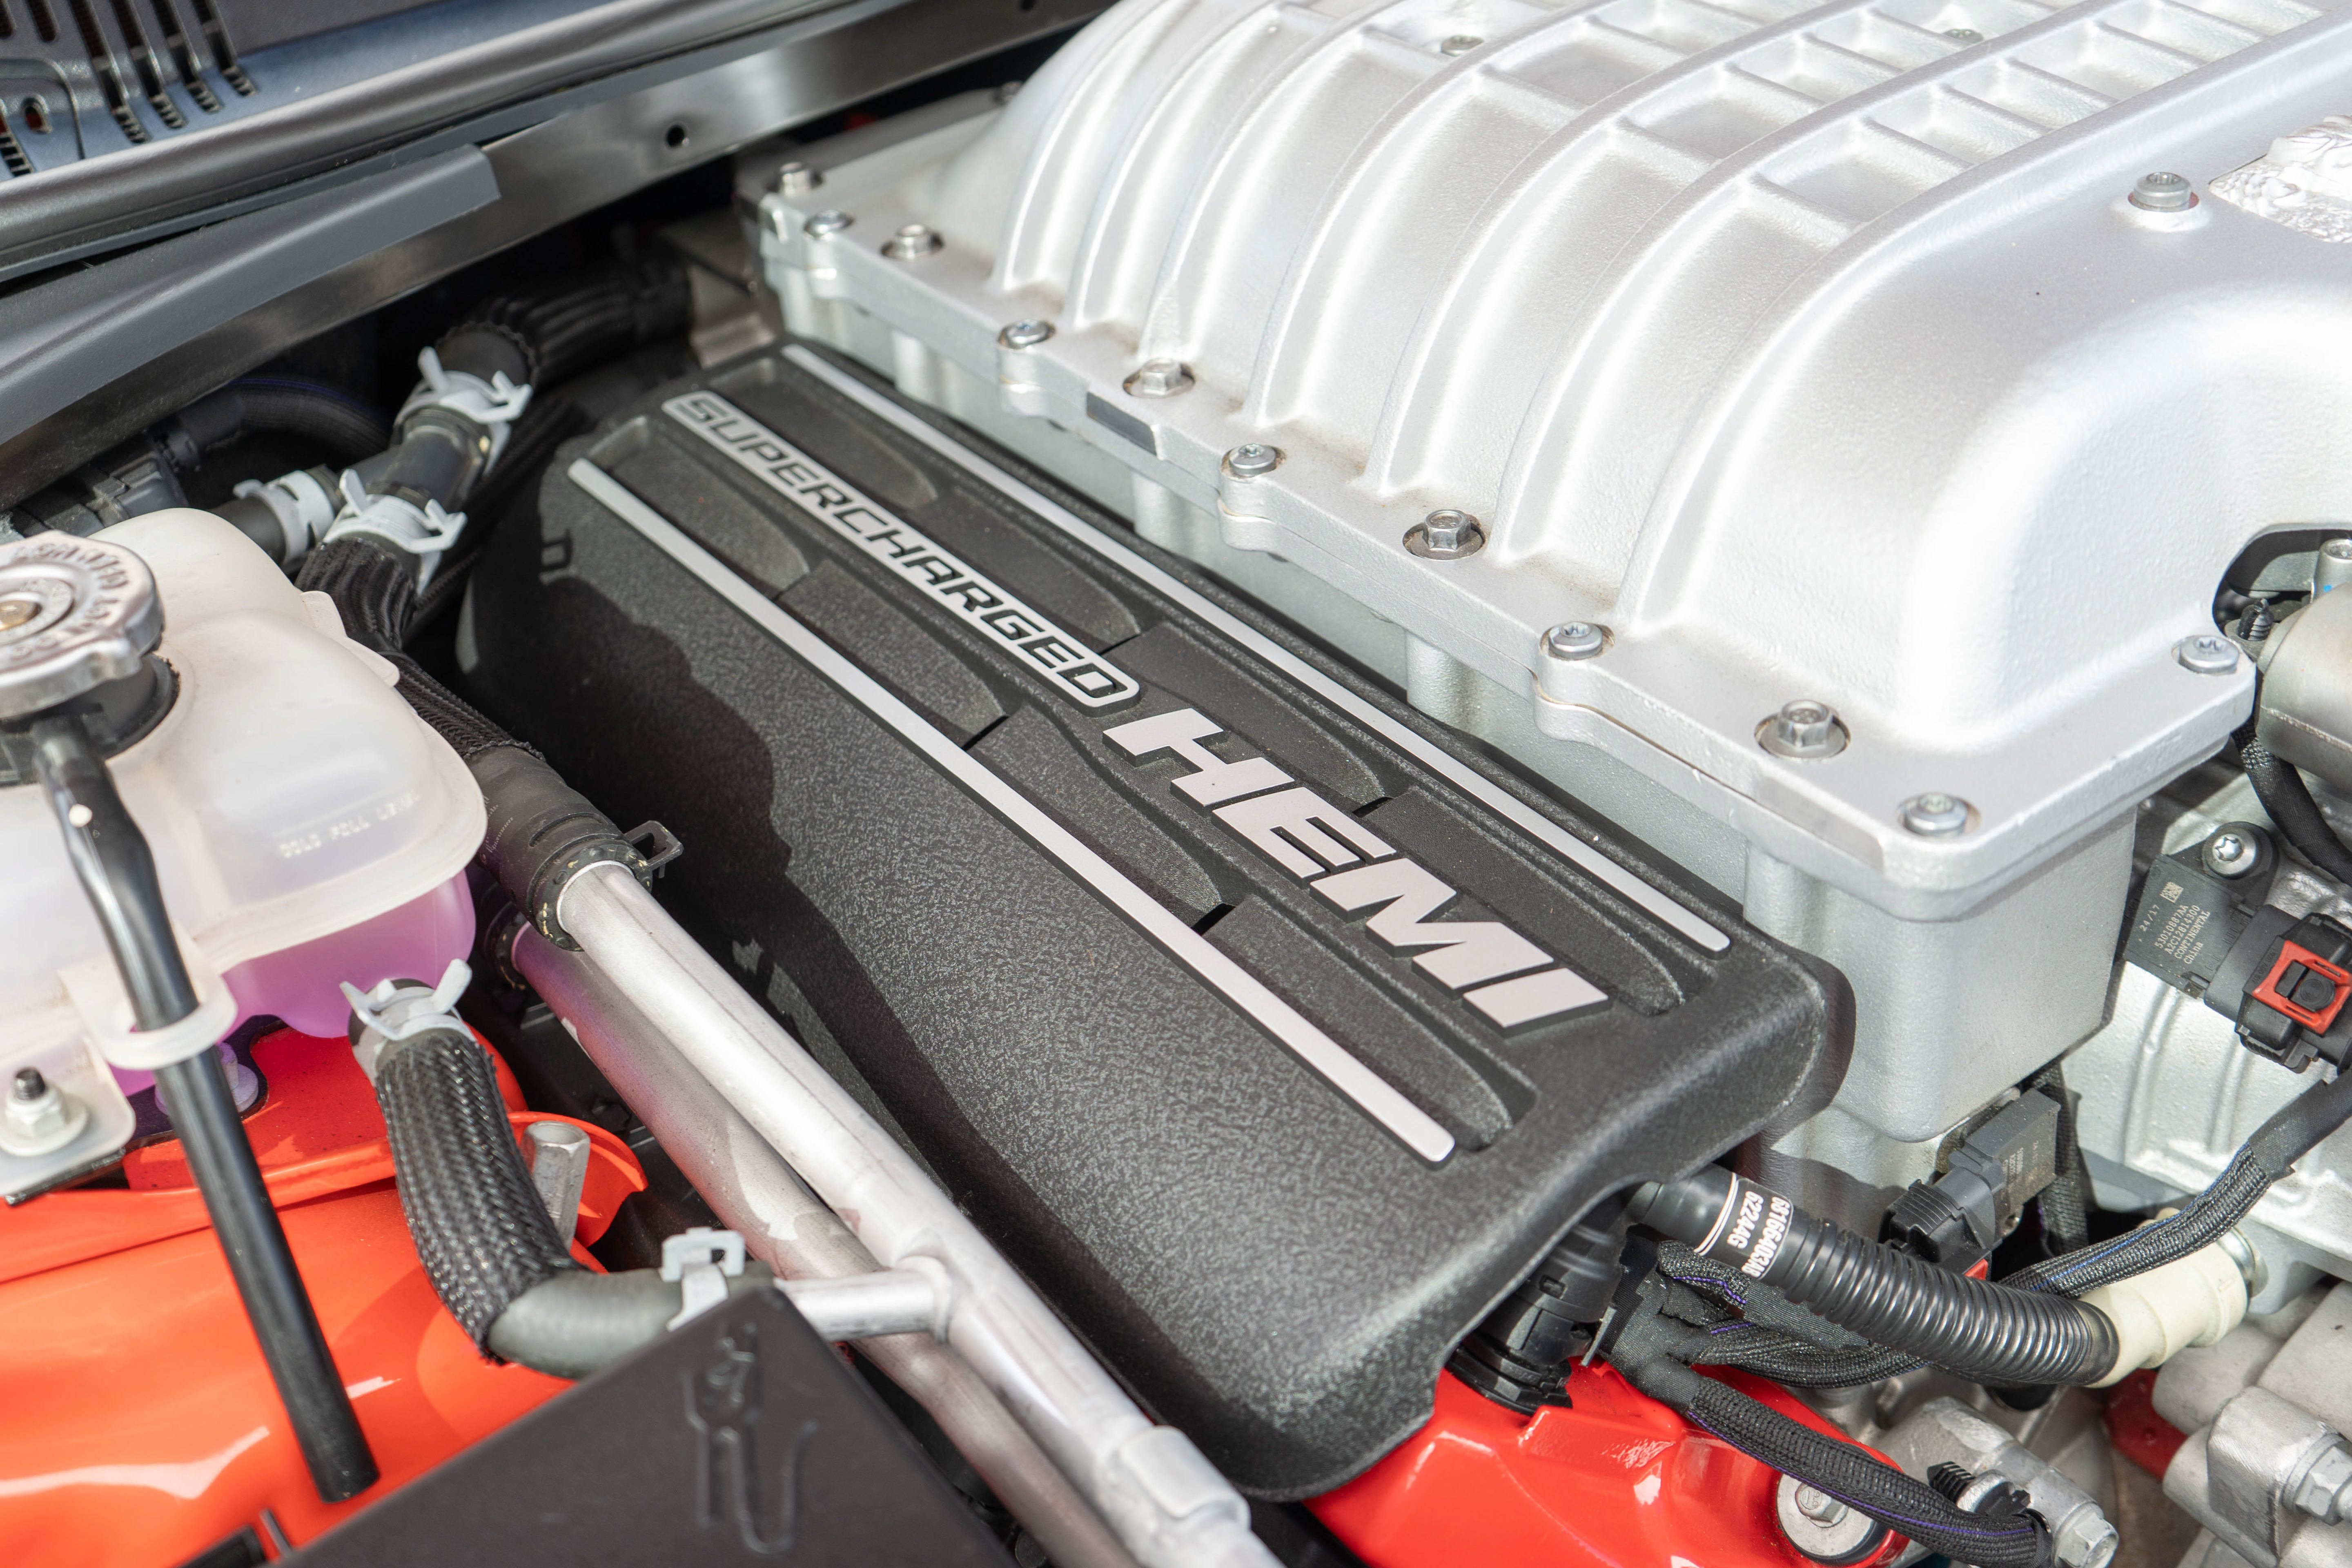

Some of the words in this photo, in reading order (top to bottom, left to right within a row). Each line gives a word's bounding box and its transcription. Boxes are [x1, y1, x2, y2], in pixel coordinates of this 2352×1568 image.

[676, 399, 1128, 698] SUPERCHARGED
[1102, 708, 1609, 1030] HEMI
[2139, 904, 2160, 932] 24/17
[2154, 904, 2189, 949] 53010887AA
[2164, 905, 2200, 955] A2C12814300
[2174, 910, 2210, 960] CONTINENTAL
[2183, 941, 2204, 964] China
[1727, 1191, 1764, 1249] 62244G
[1741, 1196, 1790, 1278] 68166403AB
